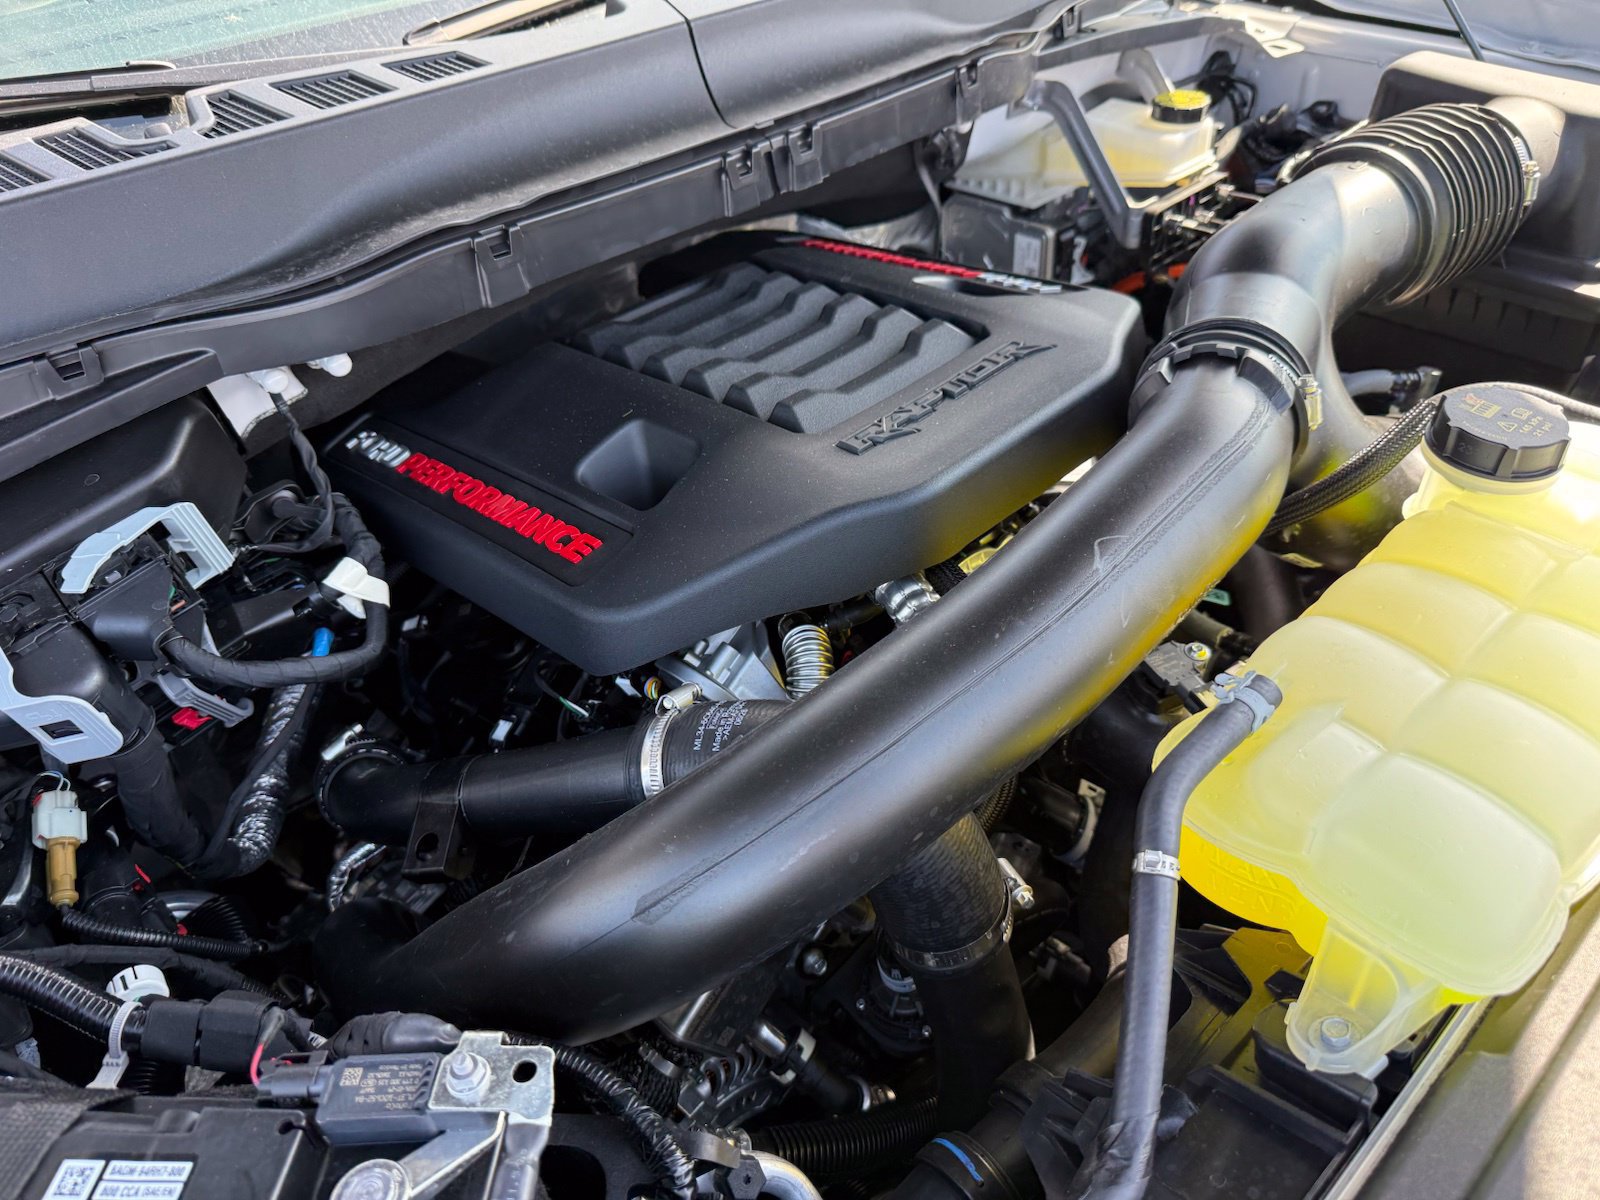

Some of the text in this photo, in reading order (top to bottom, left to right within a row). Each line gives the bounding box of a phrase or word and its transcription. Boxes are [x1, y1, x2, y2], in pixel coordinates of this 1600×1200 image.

[834, 341, 1057, 455] RAPTOR
[395, 452, 603, 564] PERFORMANCE
[712, 726, 724, 751] Made
